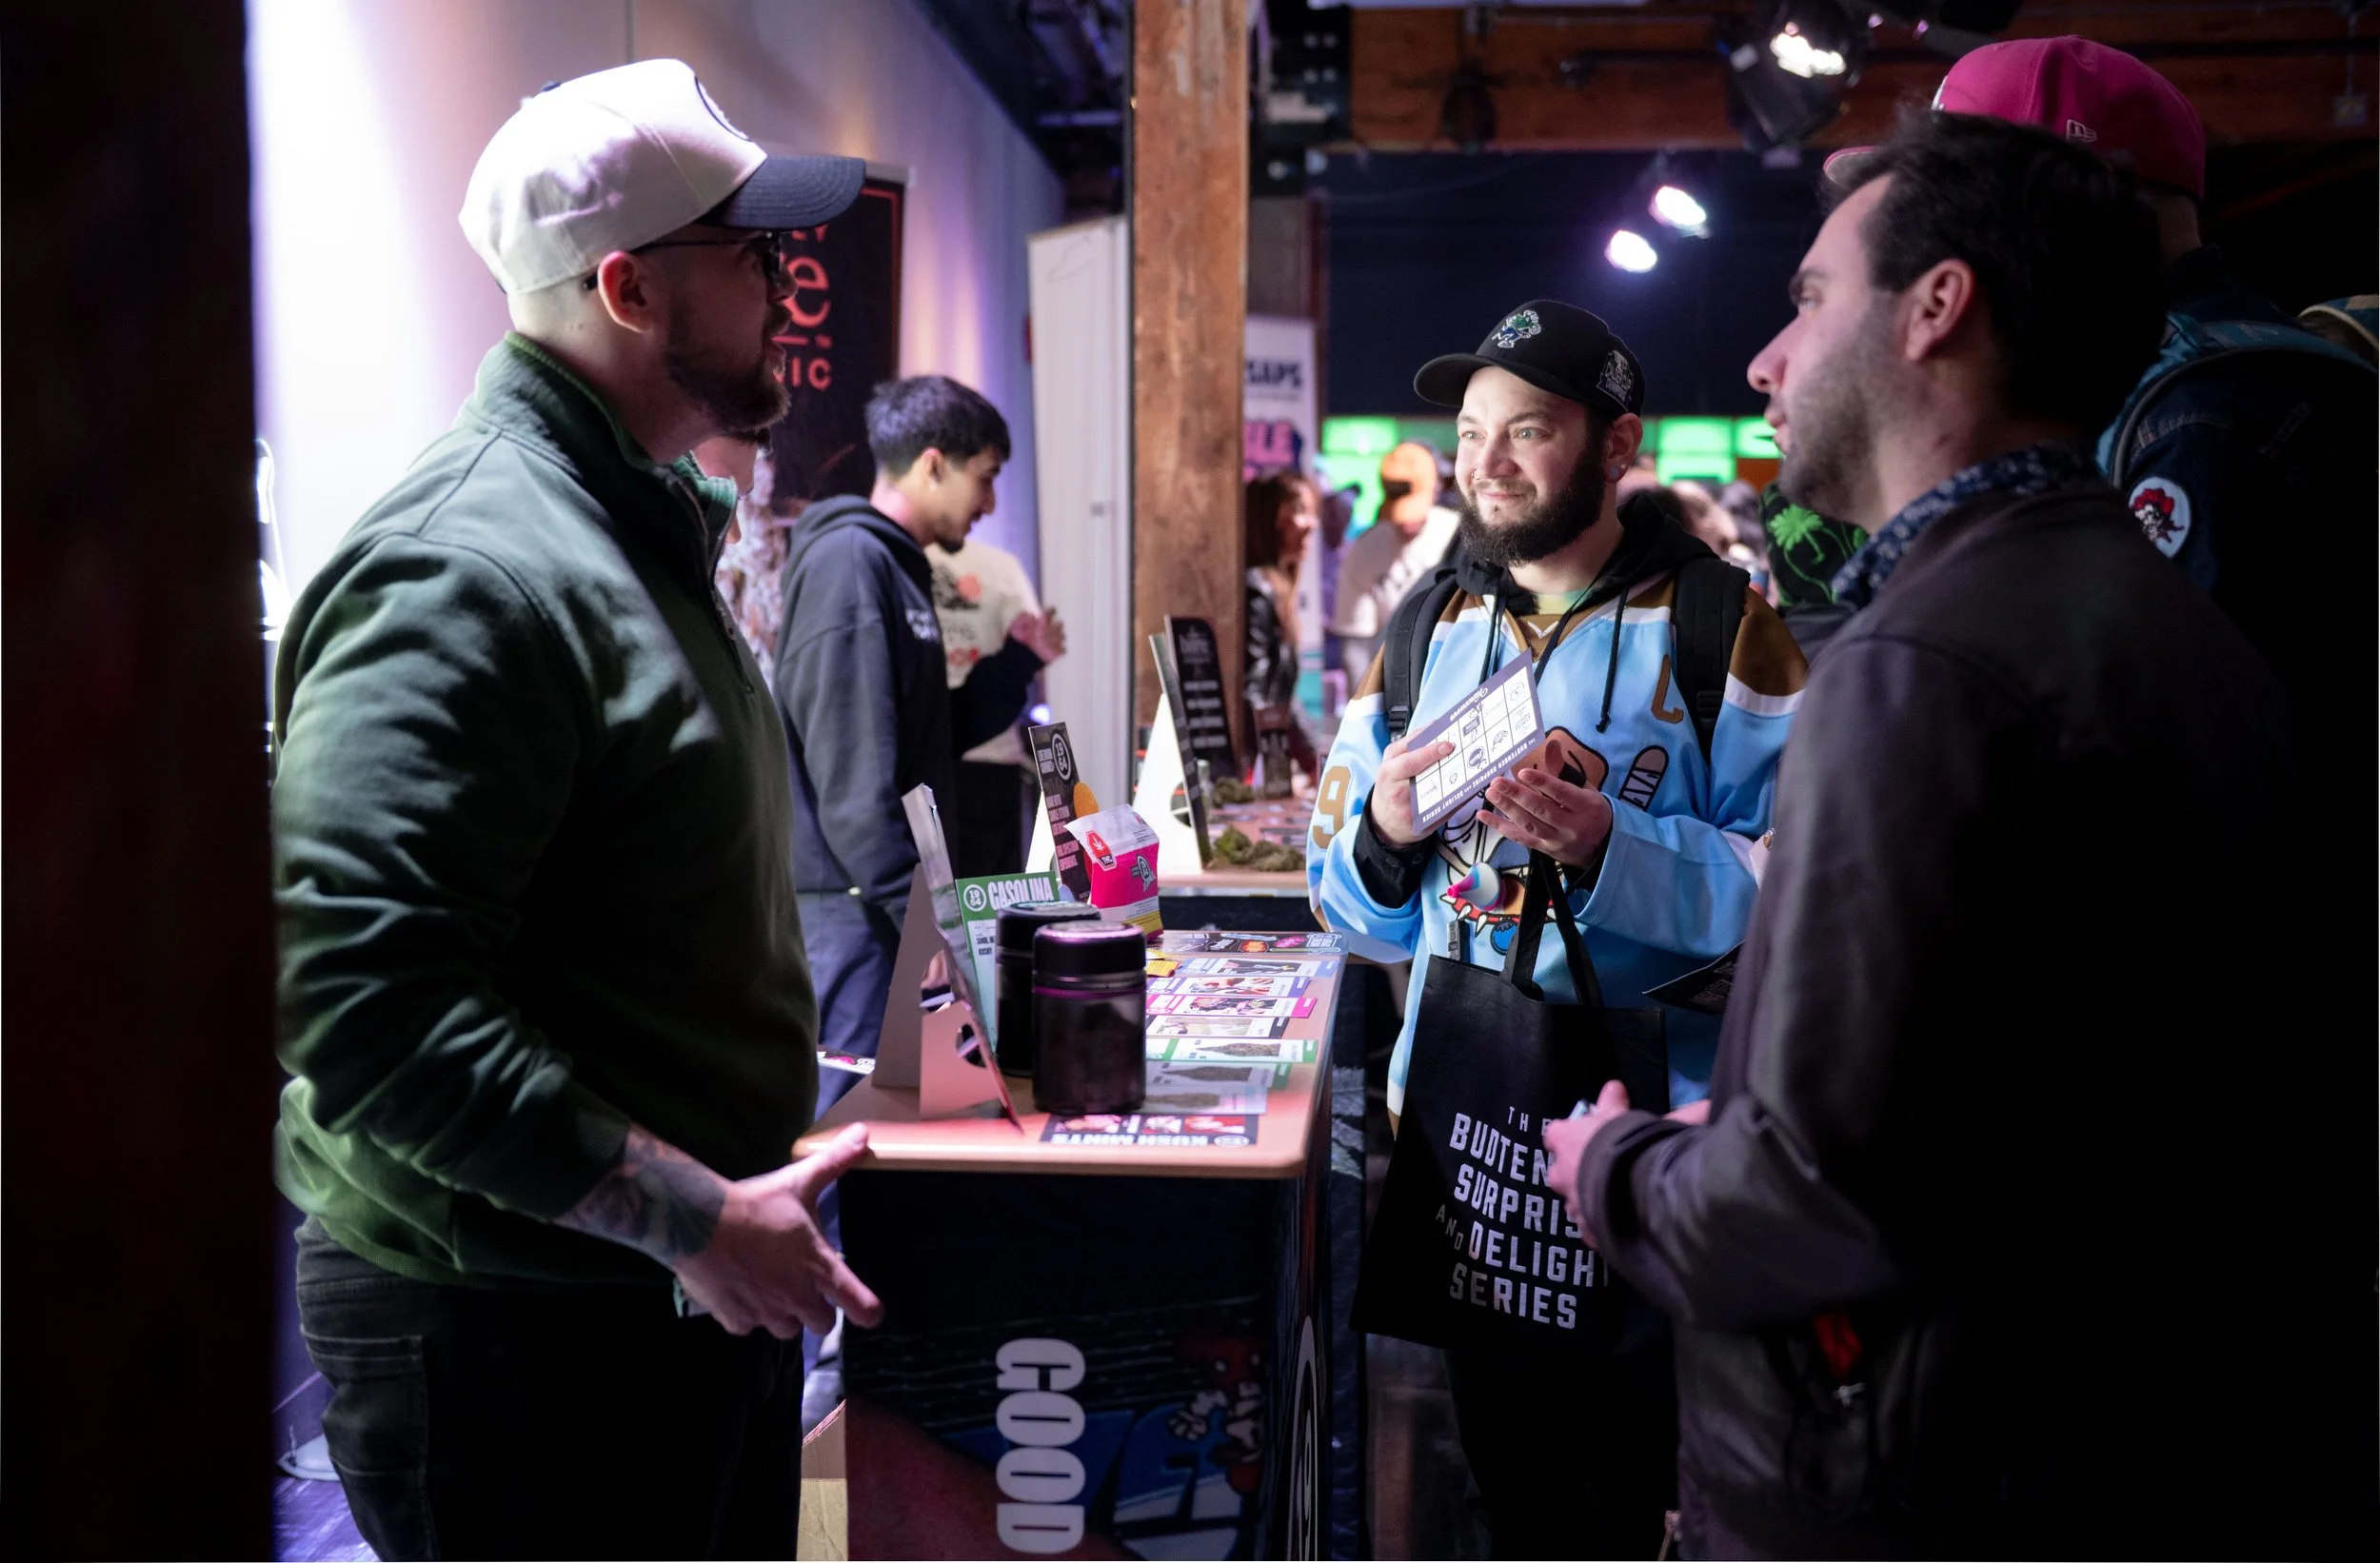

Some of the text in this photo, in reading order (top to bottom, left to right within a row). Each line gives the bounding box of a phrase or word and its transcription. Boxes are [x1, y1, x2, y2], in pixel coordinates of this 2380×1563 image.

[1312, 765, 1352, 849] 9
[1449, 1112, 1555, 1187] BUDTEN
[1454, 1163, 1582, 1238] SURPRIS
[1435, 1203, 1609, 1287] AND DELIGH
[1449, 1262, 1577, 1330] SERIES
[996, 1337, 1085, 1554] GOOD
